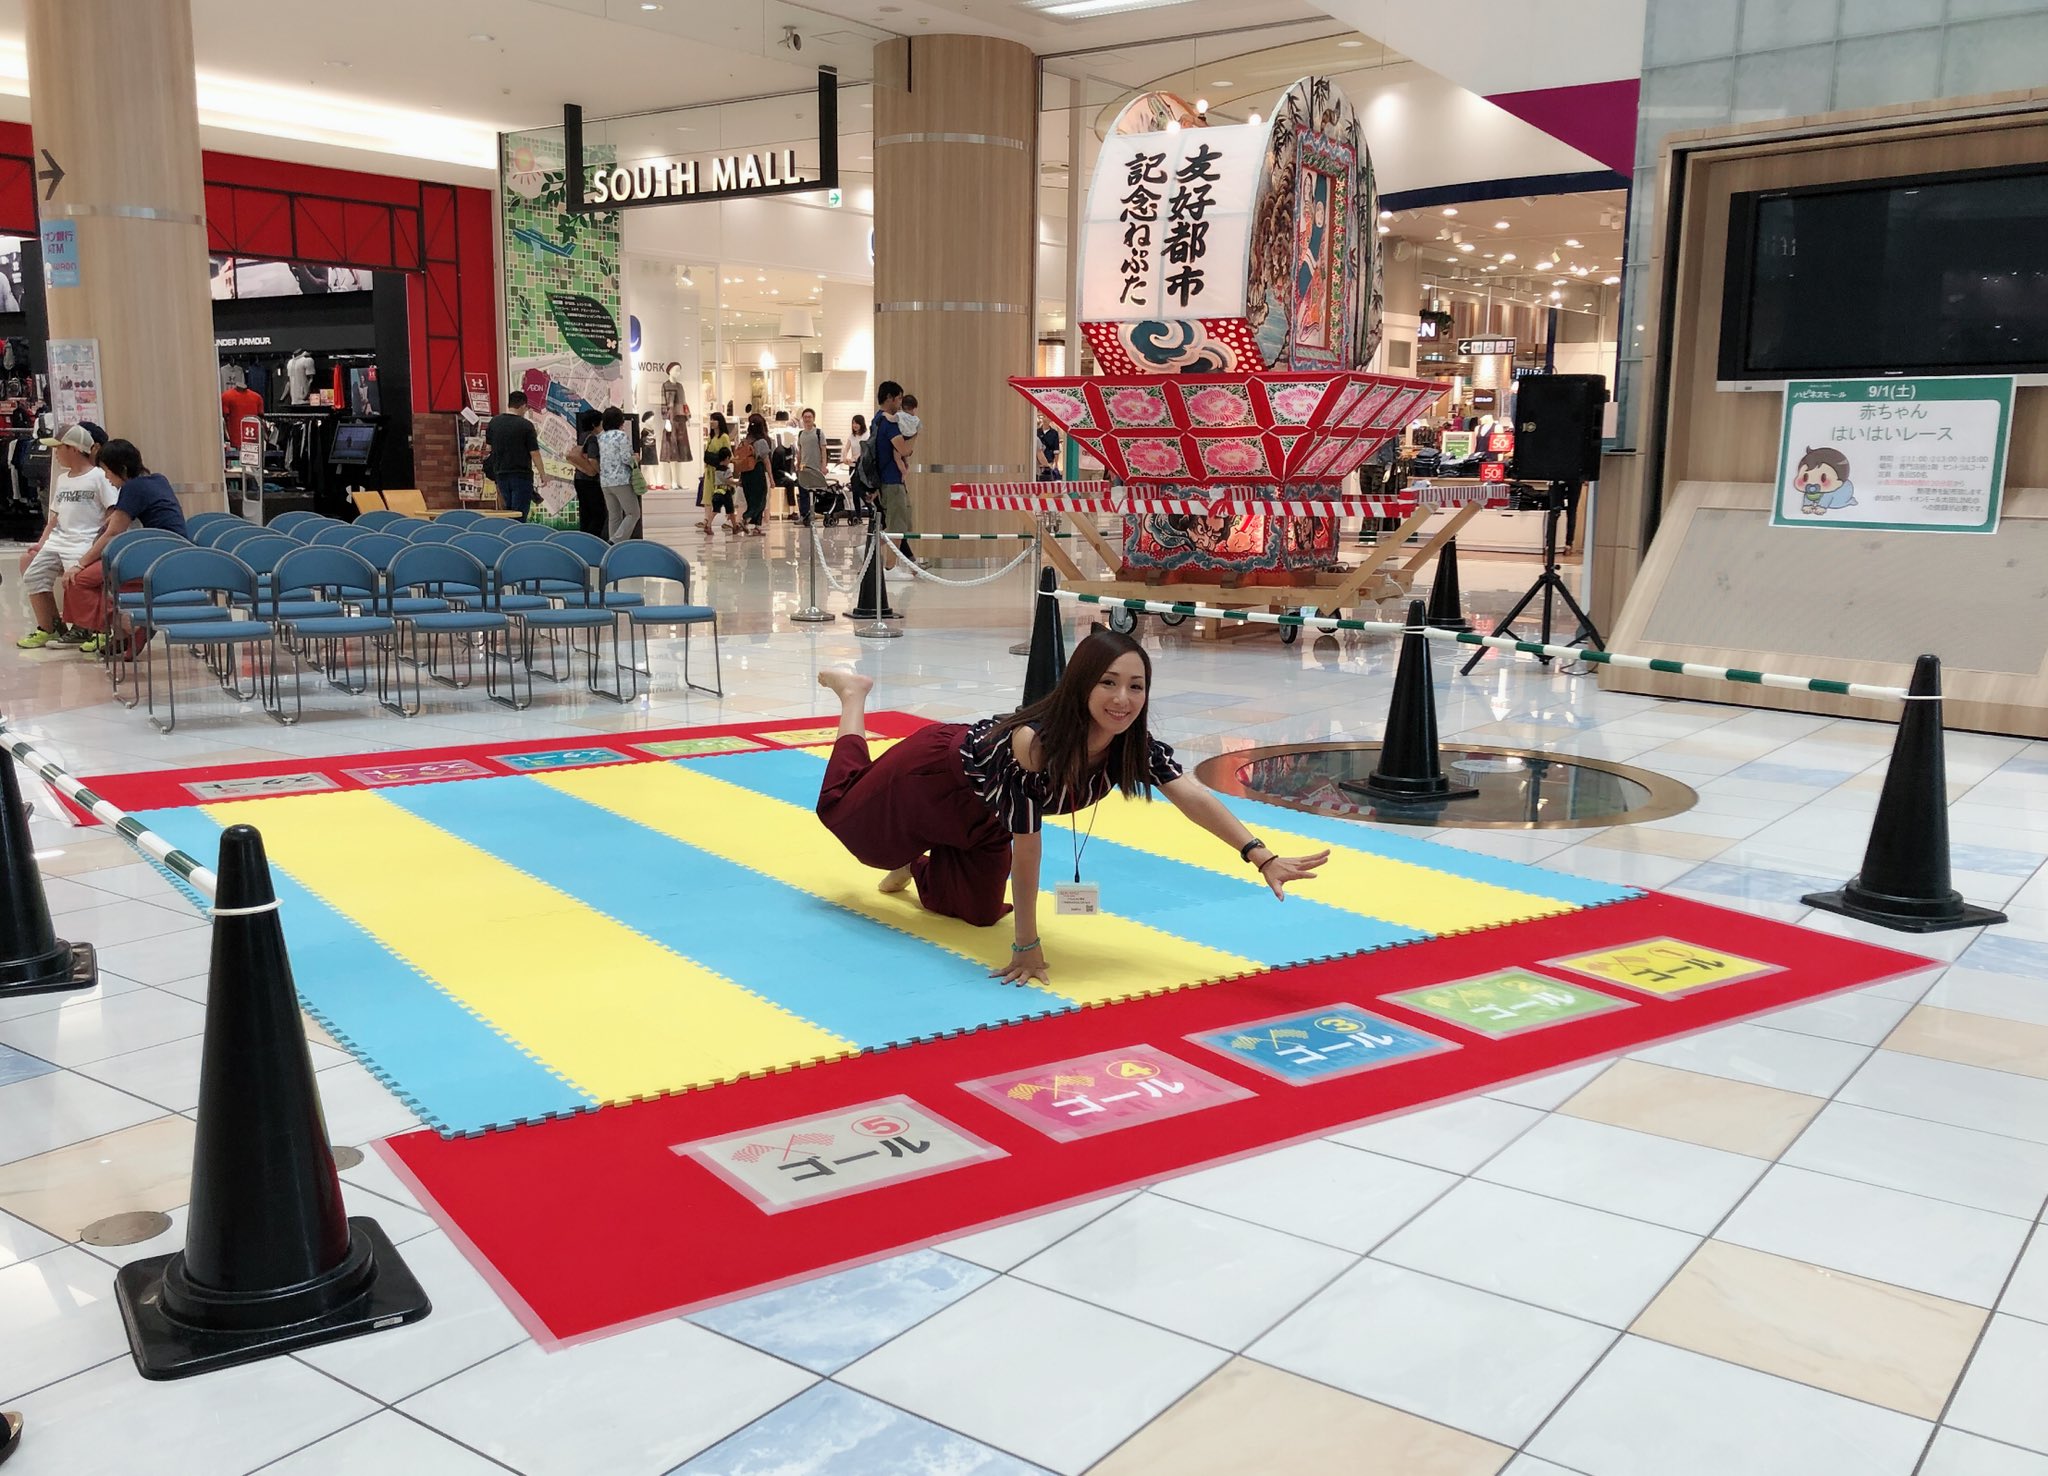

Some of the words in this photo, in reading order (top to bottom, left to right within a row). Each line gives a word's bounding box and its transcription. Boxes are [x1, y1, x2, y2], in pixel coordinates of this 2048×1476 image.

[594, 160, 699, 204] SOUTH
[712, 150, 803, 192] MALL
[1120, 152, 1168, 306] 記念ねぷた
[1160, 144, 1222, 307] 友好都市
[1868, 385, 1917, 399] 9/1(土)
[1859, 403, 1928, 421] 赤ちゃん
[1831, 425, 1954, 442] はいはいレース
[202, 775, 315, 789] スタート
[1631, 958, 1726, 983] ゴール
[1470, 991, 1576, 1021] ゴール
[1274, 1032, 1395, 1065] ゴール
[1051, 1078, 1185, 1118] ゴール
[777, 1136, 931, 1183] ゴール
